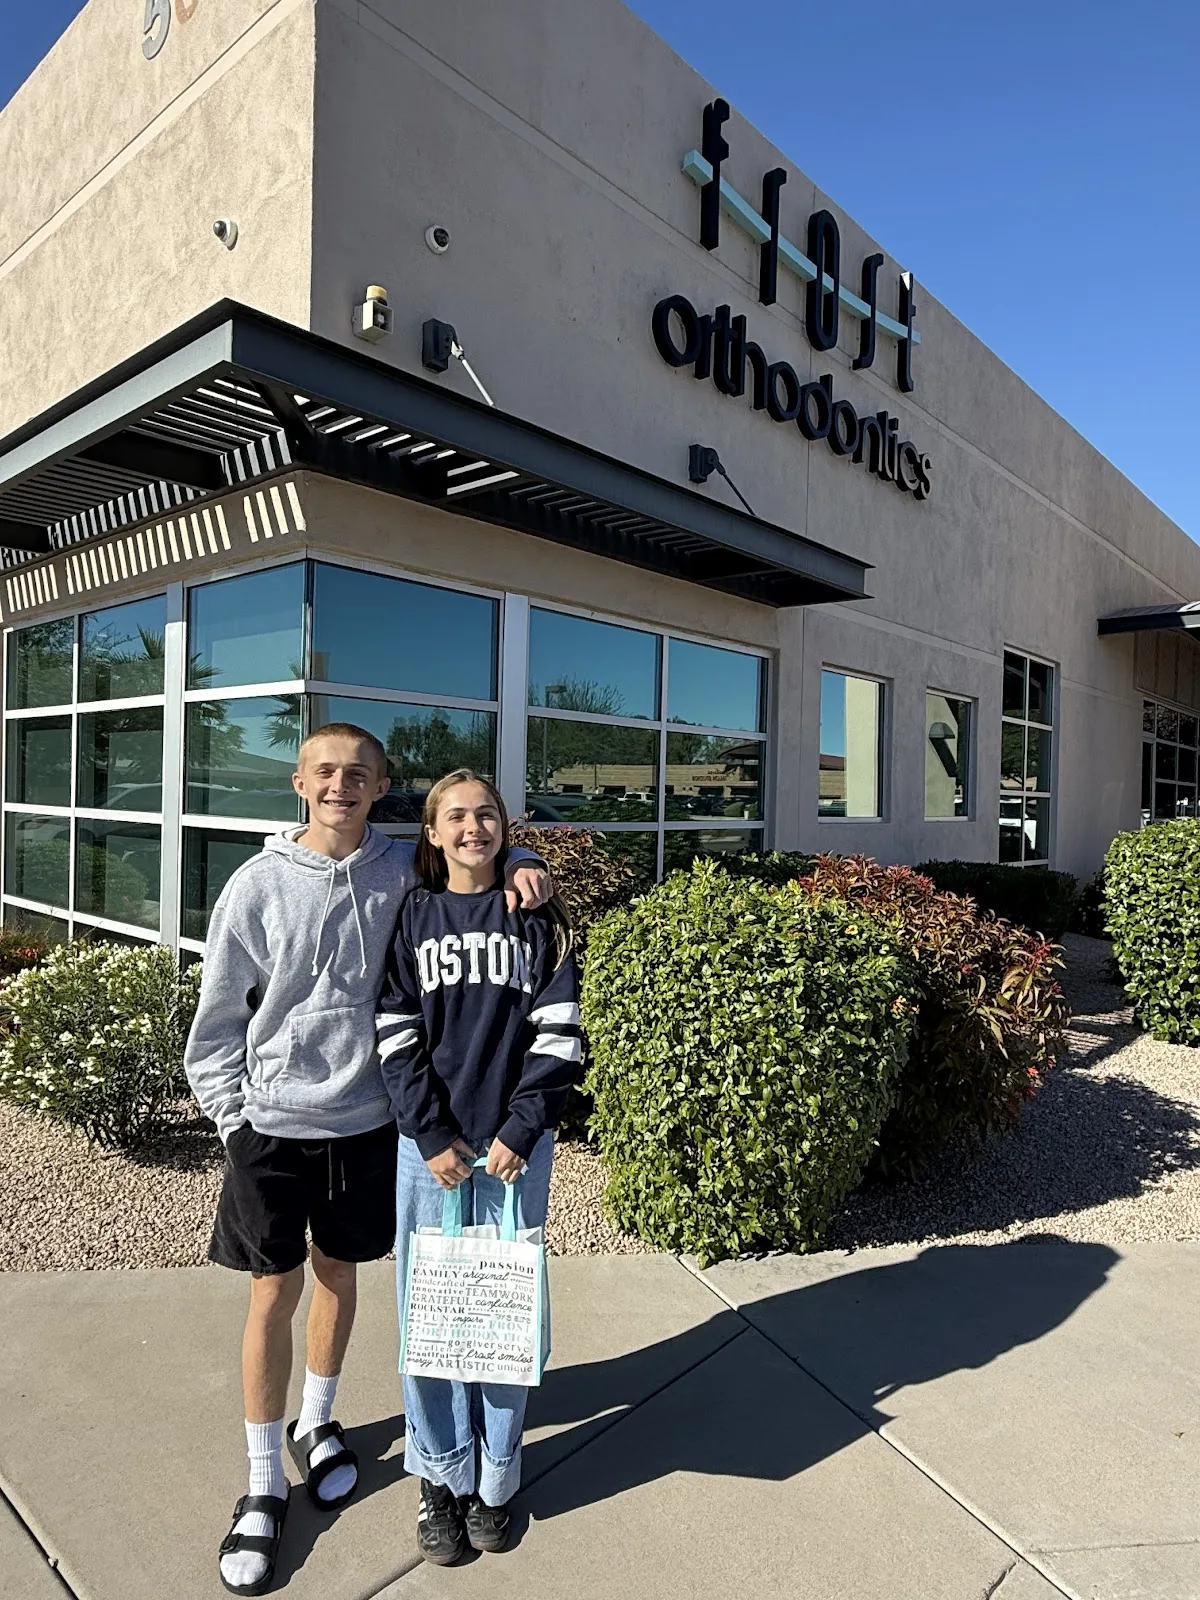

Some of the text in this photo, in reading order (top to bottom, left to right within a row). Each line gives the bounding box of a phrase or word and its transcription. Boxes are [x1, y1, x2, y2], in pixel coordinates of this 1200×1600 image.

[700, 97, 917, 393] frost
[652, 294, 932, 500] orthodontics
[415, 932, 532, 998] OSTON
[480, 1261, 534, 1274] passion
[412, 1277, 465, 1287] handcrafted
[413, 1268, 461, 1278] FAMILY
[463, 1271, 509, 1284] original
[412, 1293, 532, 1311] GRATEFUL confidence
[466, 1287, 533, 1304] TEAMWORK
[410, 1303, 465, 1314] ROCKSTAR
[424, 1313, 449, 1322] FUN
[422, 1328, 532, 1344] ORTHODONTICS
[448, 1340, 530, 1353] go-giver serve
[463, 1349, 496, 1361] frost
[498, 1353, 533, 1363] smiles
[435, 1359, 495, 1372] ARTISTIC
[497, 1364, 533, 1375] unique
